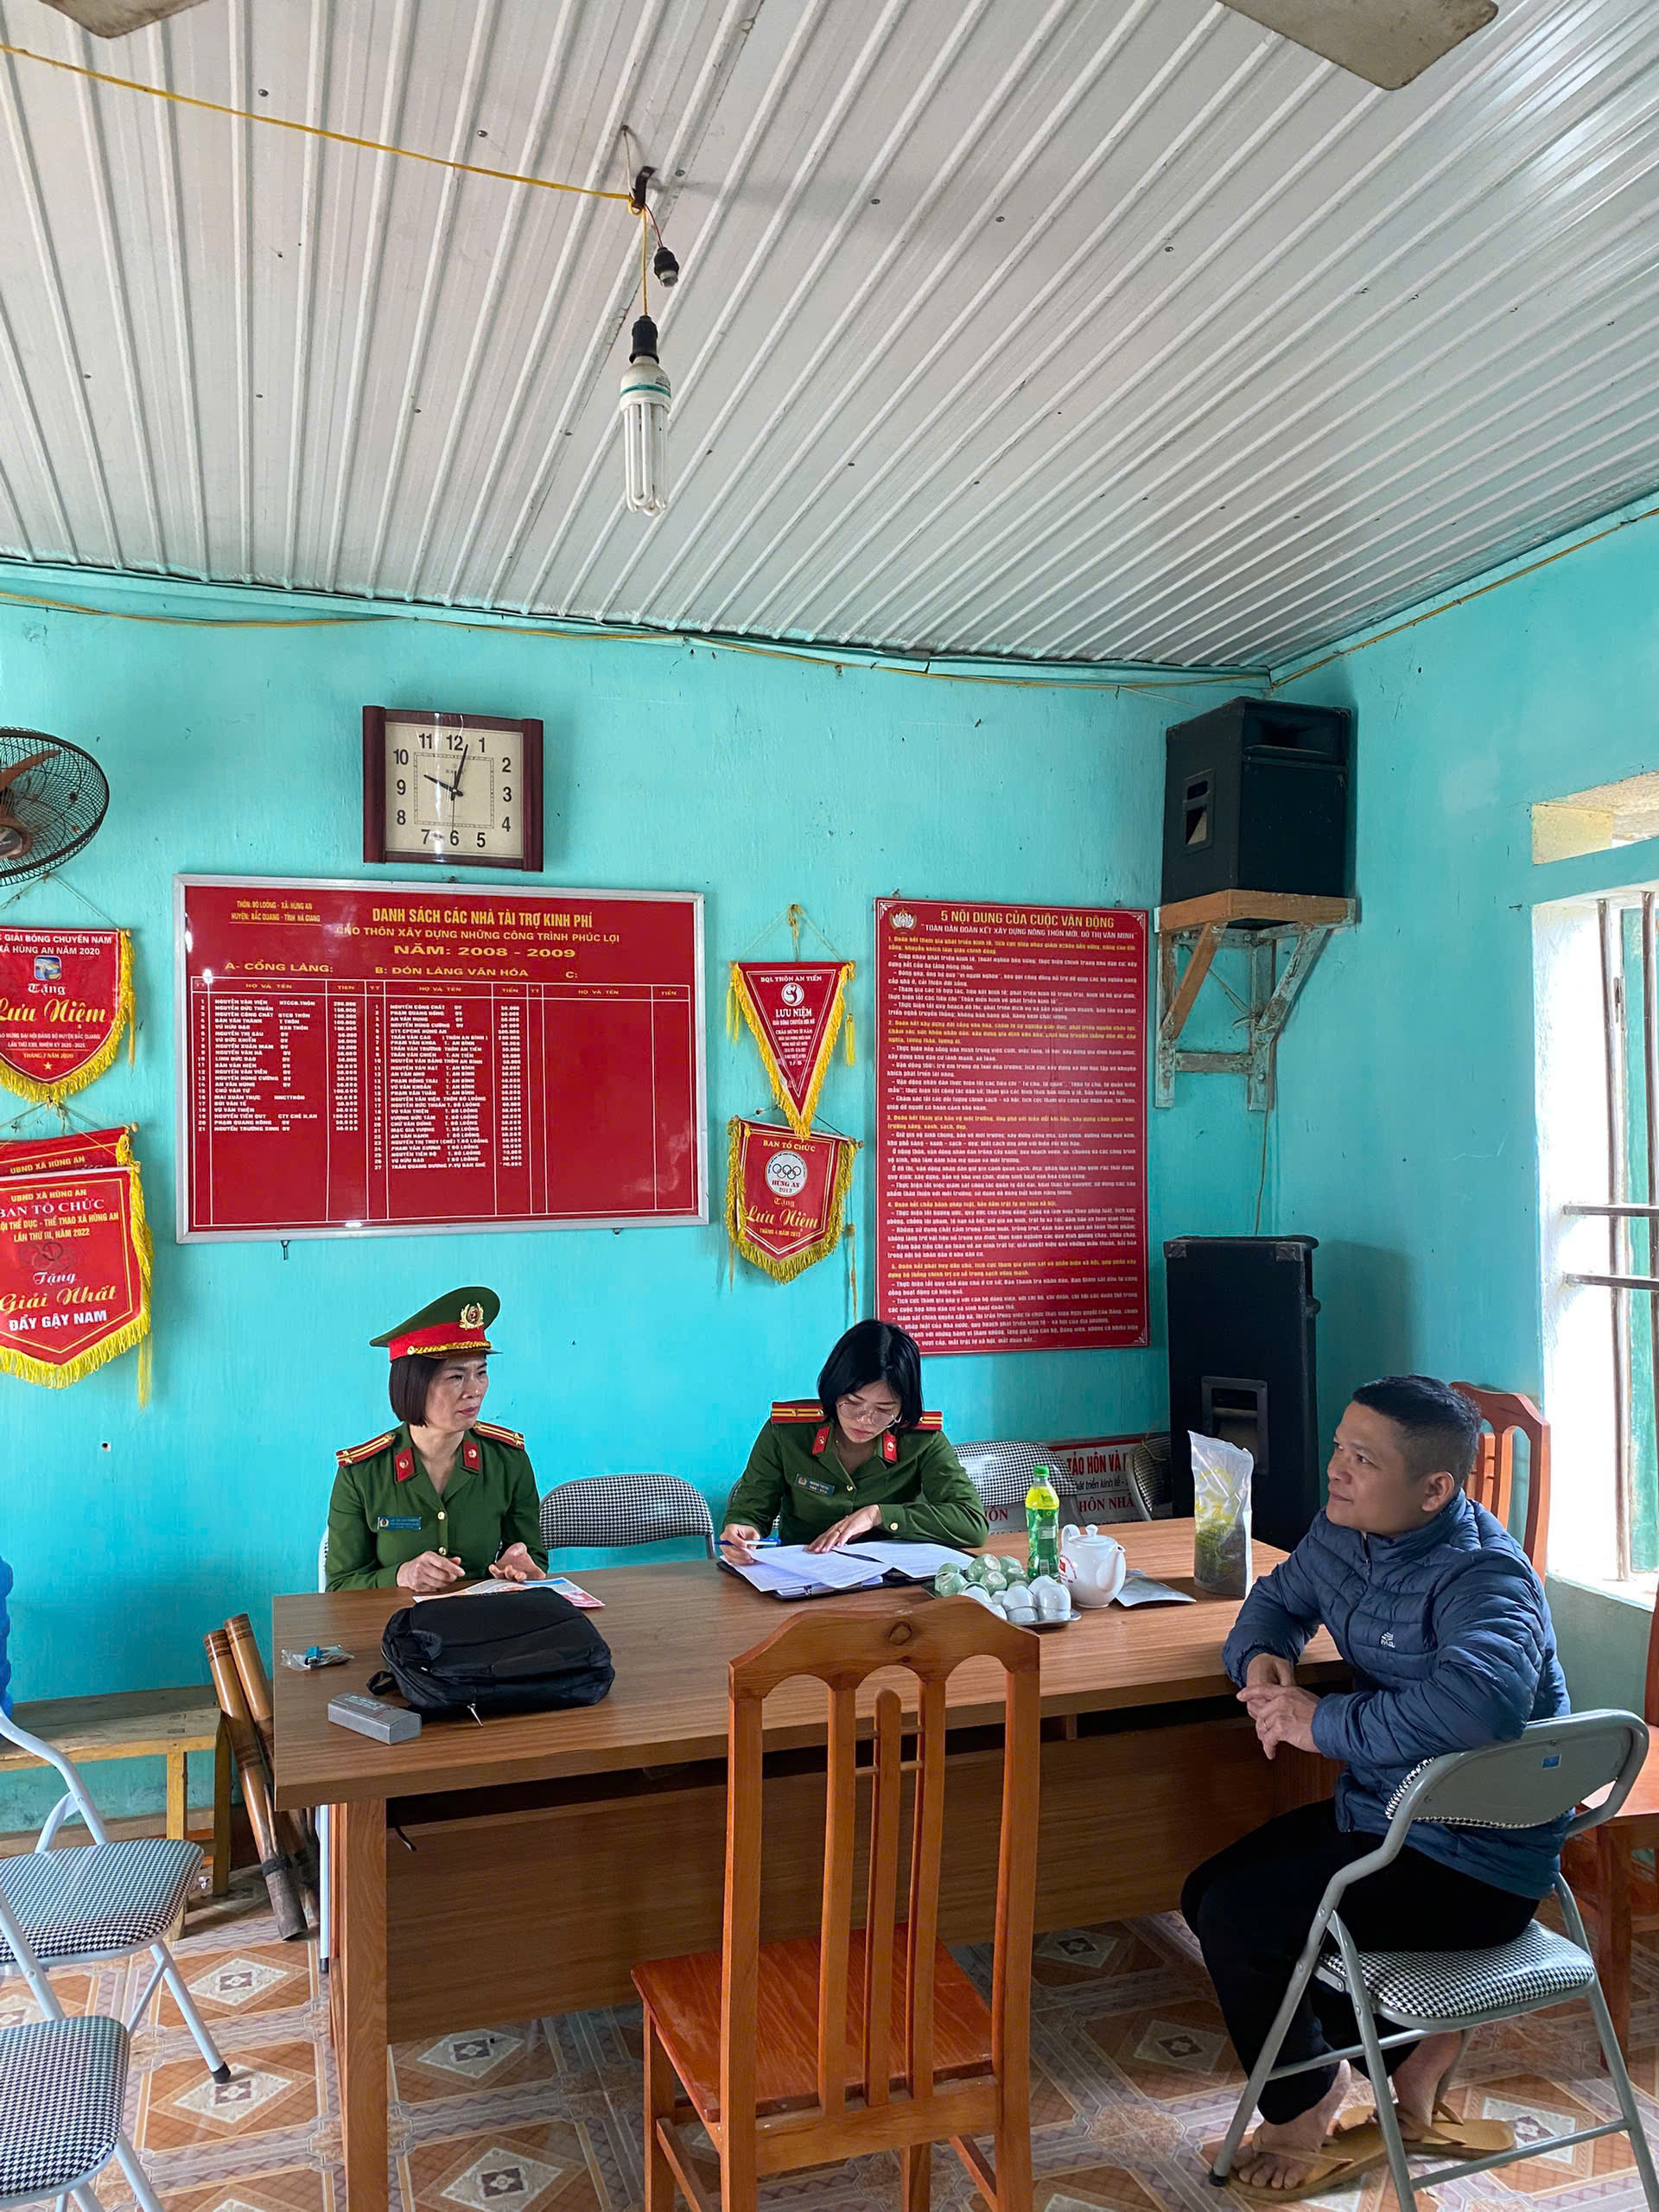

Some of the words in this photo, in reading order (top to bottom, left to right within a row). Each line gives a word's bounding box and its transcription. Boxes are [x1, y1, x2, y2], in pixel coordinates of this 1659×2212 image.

[418, 733, 432, 749] 11
[446, 734, 463, 751] 12
[479, 737, 485, 753] 1
[393, 749, 409, 765] 10
[502, 757, 512, 772] 2
[397, 779, 406, 795] 9
[503, 786, 512, 802] 3
[397, 810, 406, 825] 8
[502, 817, 511, 832] 4
[422, 830, 430, 844] 7
[450, 830, 460, 846] 6
[477, 833, 486, 848] 5
[372, 907, 405, 922] DANH
[409, 906, 441, 923] SÁCH
[444, 907, 467, 925] CÁC
[471, 908, 494, 925] NHÀ
[498, 909, 515, 925] TÀI
[518, 912, 541, 930] TRỢ
[543, 912, 570, 926] KINH
[574, 912, 593, 928] PHÍ
[941, 911, 947, 921] 5
[951, 909, 969, 924] NỘI
[973, 912, 1002, 923] DUNG
[1006, 911, 1027, 925] CỦA
[1030, 912, 1058, 928] CUỘC
[1061, 913, 1083, 929] VẬN
[1085, 914, 1115, 930] ĐỘNG
[363, 926, 394, 937] THÔN
[397, 927, 422, 938] XÂY
[425, 930, 457, 940] DỰNG
[461, 929, 499, 940] NHỮNG
[503, 930, 534, 940] CÔNG
[537, 931, 569, 941] TRÌNH
[572, 932, 601, 942] PHÚC
[603, 934, 620, 944] LỢI
[13, 945, 38, 954] HÙNG
[56, 945, 77, 954] NĂM
[394, 943, 451, 955] NĂM:
[458, 947, 508, 957] 2008
[527, 949, 575, 957] 2009
[28, 983, 66, 995] Tặng
[0, 997, 37, 1021] Lưu
[44, 998, 105, 1029] Niệm
[793, 1006, 812, 1019] NIỆM
[781, 1141, 791, 1149] TỔ
[793, 1144, 816, 1153] CHỨC
[10, 1165, 33, 1173] UBND
[35, 1161, 46, 1170] XÃ
[48, 1158, 71, 1166] HÙNG
[11, 1193, 33, 1202] UBND
[36, 1191, 47, 1199] XÃ
[50, 1189, 73, 1198] HÙNG
[0, 1206, 28, 1218] BAN
[31, 1202, 54, 1214] TỔ
[58, 1198, 105, 1211] CHỨC
[10, 1218, 22, 1230] THỂ
[24, 1220, 38, 1230] DỤC
[45, 1216, 57, 1226] THỂ
[59, 1215, 76, 1225] THAO
[78, 1213, 88, 1224] XÃ
[88, 1213, 107, 1222] HÙNG
[109, 1211, 119, 1220] AN
[746, 1205, 774, 1224] Lưu
[779, 1209, 817, 1232] Niệm
[14, 1230, 28, 1243] LẦN
[29, 1230, 43, 1241] THỨ
[55, 1227, 73, 1238] NĂM
[73, 1227, 90, 1237] 2022
[33, 1272, 76, 1286] Tặng
[0, 1291, 48, 1314] Giải
[57, 1285, 118, 1305] Nhất
[9, 1313, 36, 1332] ĐẨY
[41, 1313, 69, 1329] GẬY
[74, 1310, 107, 1325] NAM
[1066, 1452, 1084, 1476] TẢO
[1087, 1452, 1106, 1474] HÔN
[1109, 1450, 1122, 1471] VÀ
[1079, 1497, 1105, 1512] HÔN
[1109, 1492, 1134, 1509] NHÂ
[985, 1505, 1007, 1521] ÔN
